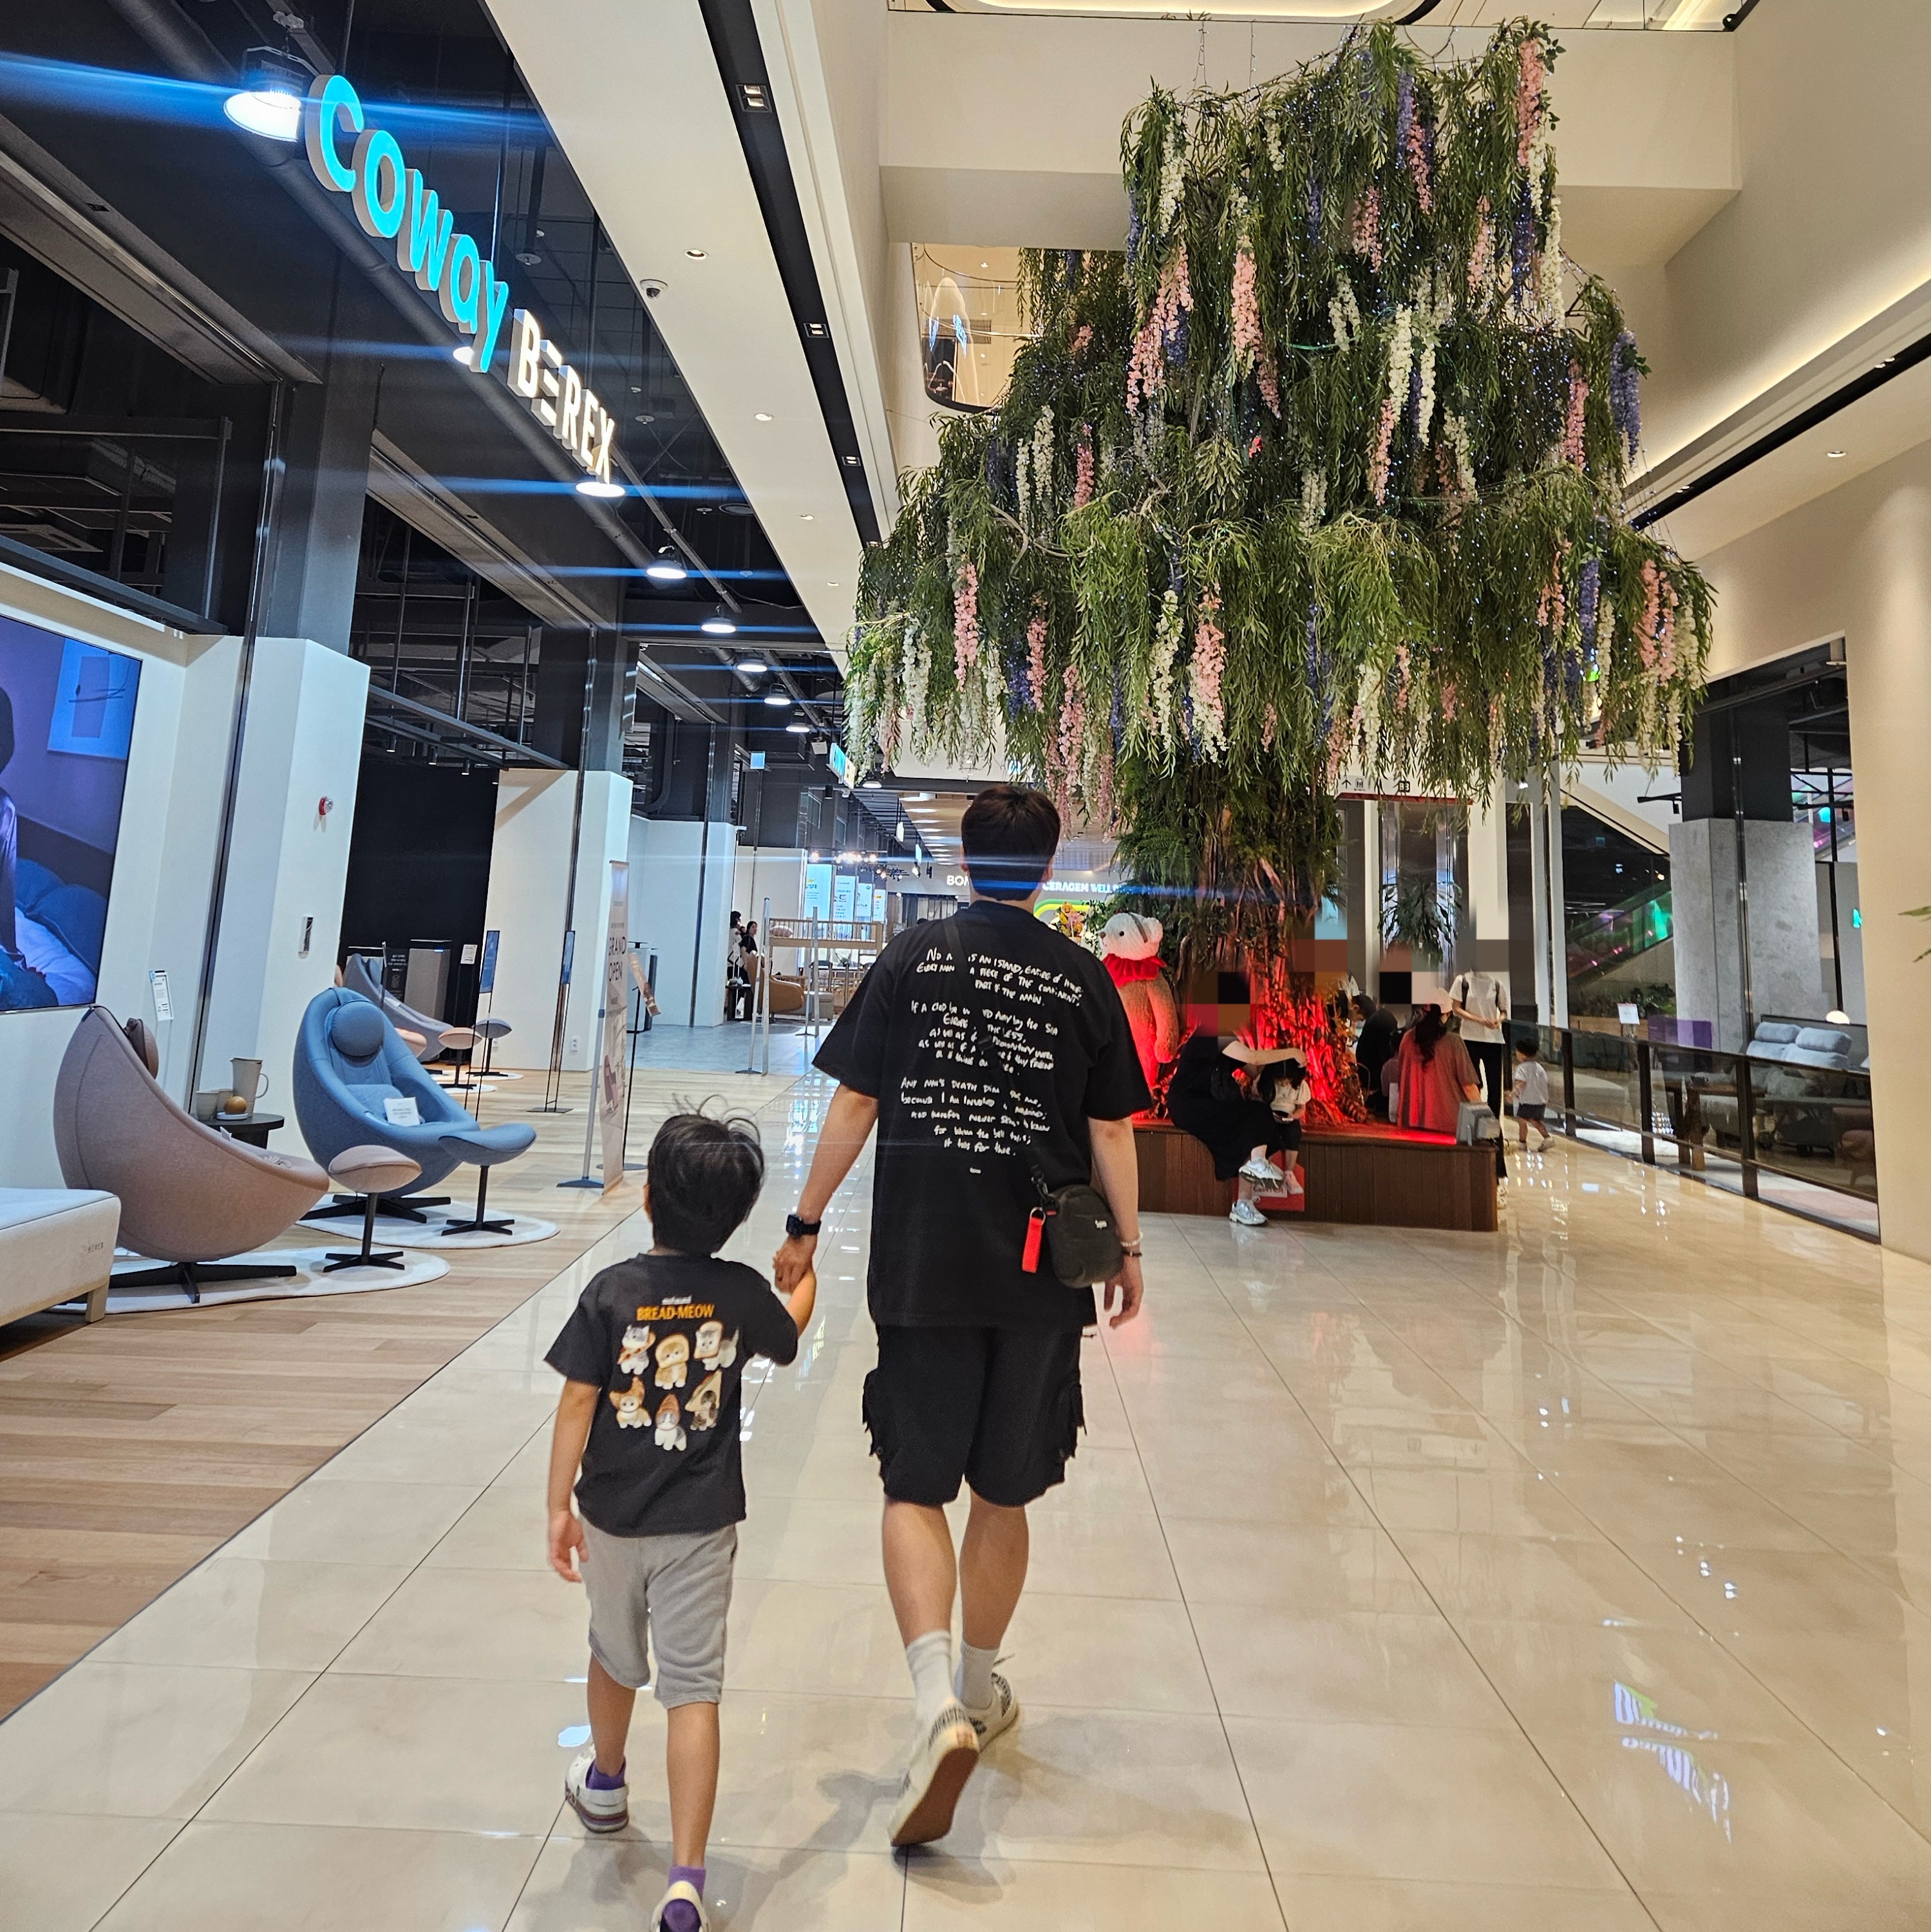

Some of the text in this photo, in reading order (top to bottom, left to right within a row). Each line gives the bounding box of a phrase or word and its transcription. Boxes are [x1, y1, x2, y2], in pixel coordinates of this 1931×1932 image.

[305, 75, 508, 372] Coway
[609, 936, 626, 956] GRAND
[608, 961, 623, 982] OPEN
